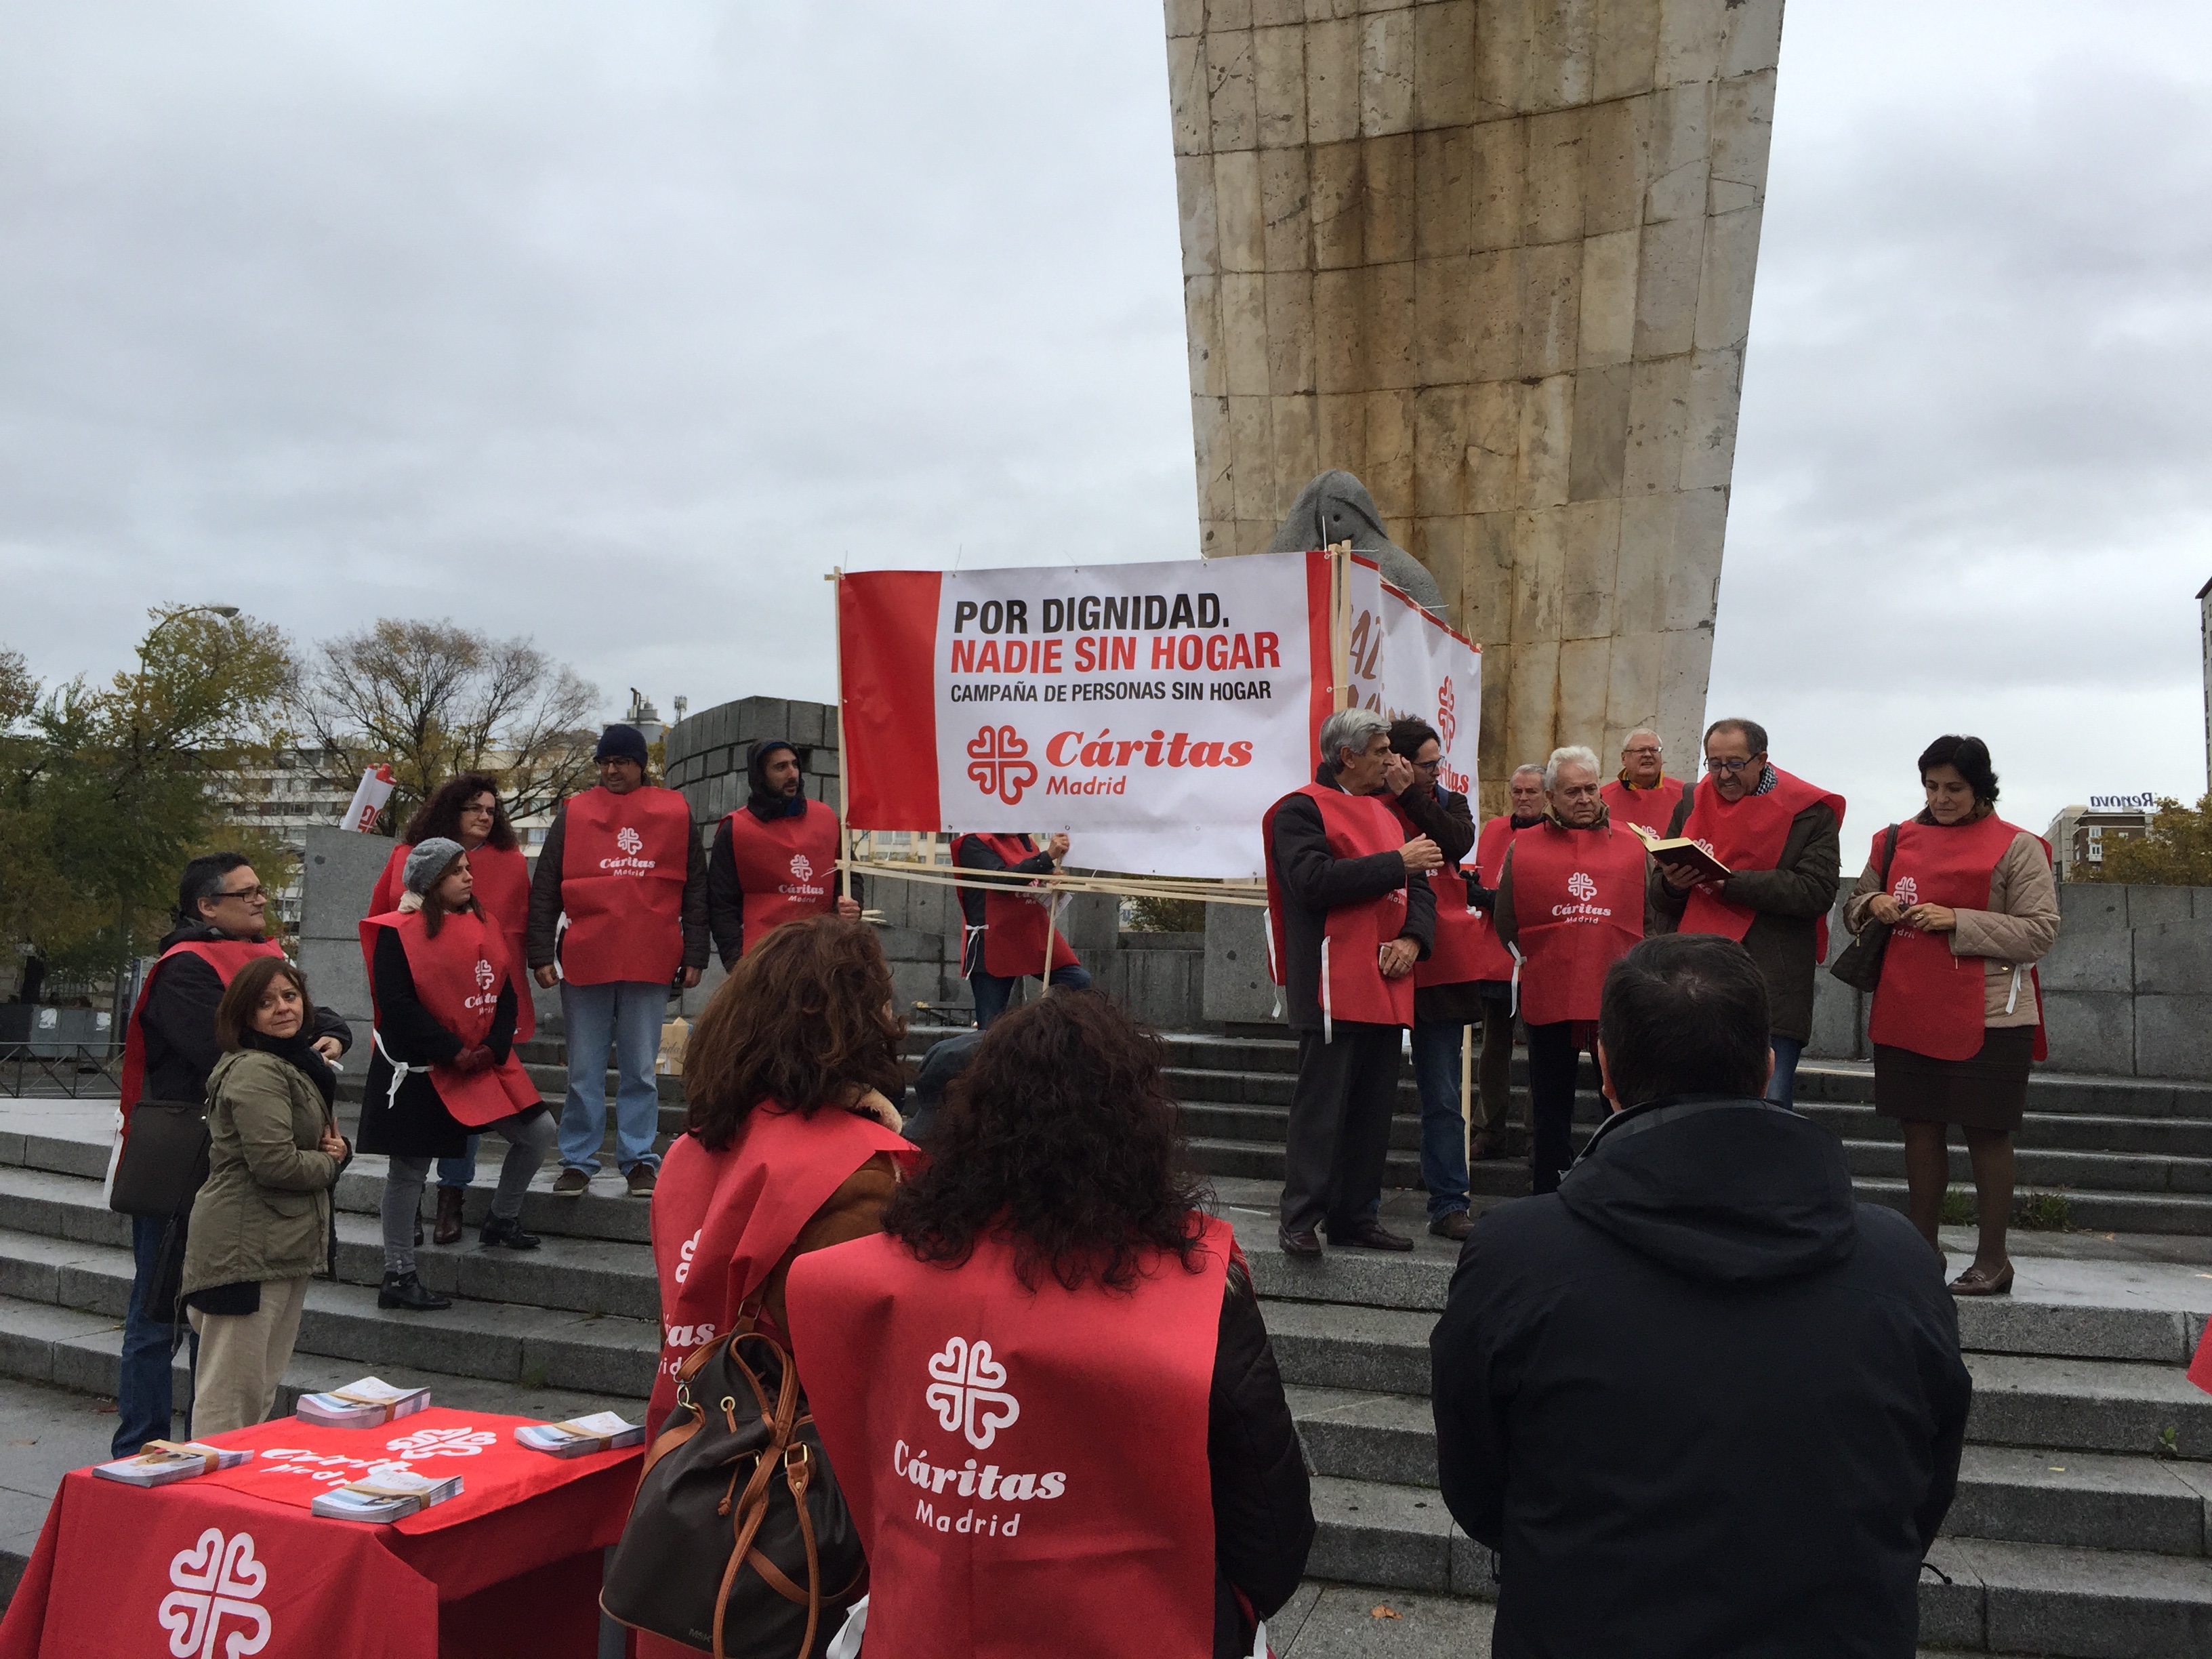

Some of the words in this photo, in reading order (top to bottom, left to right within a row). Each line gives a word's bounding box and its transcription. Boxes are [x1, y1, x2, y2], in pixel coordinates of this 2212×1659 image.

[954, 600, 1028, 634] POR
[1043, 593, 1229, 633] DIGNIDAD.
[951, 639, 1063, 673] NADIE
[1075, 636, 1136, 672] SIN
[1151, 632, 1281, 671] HOGAR
[951, 681, 1038, 702] CAMPAÑA
[1044, 684, 1067, 702] DE
[1072, 682, 1166, 701] PERSONAS
[1172, 682, 1203, 700] SIN
[1210, 680, 1271, 701] HOGAR
[1046, 728, 1253, 768] Cáritas
[1046, 775, 1126, 795] Madrid
[600, 857, 656, 869] Cáritas
[613, 869, 645, 877] Madrid
[778, 884, 824, 895] Cáritas
[787, 895, 816, 903] Madrid
[1551, 903, 1612, 916] Cáritas
[1563, 916, 1599, 924] Madrid
[259, 1464, 352, 1487] Madr
[894, 1439, 1067, 1501] Cáritas
[916, 1498, 1021, 1537] Madrid
